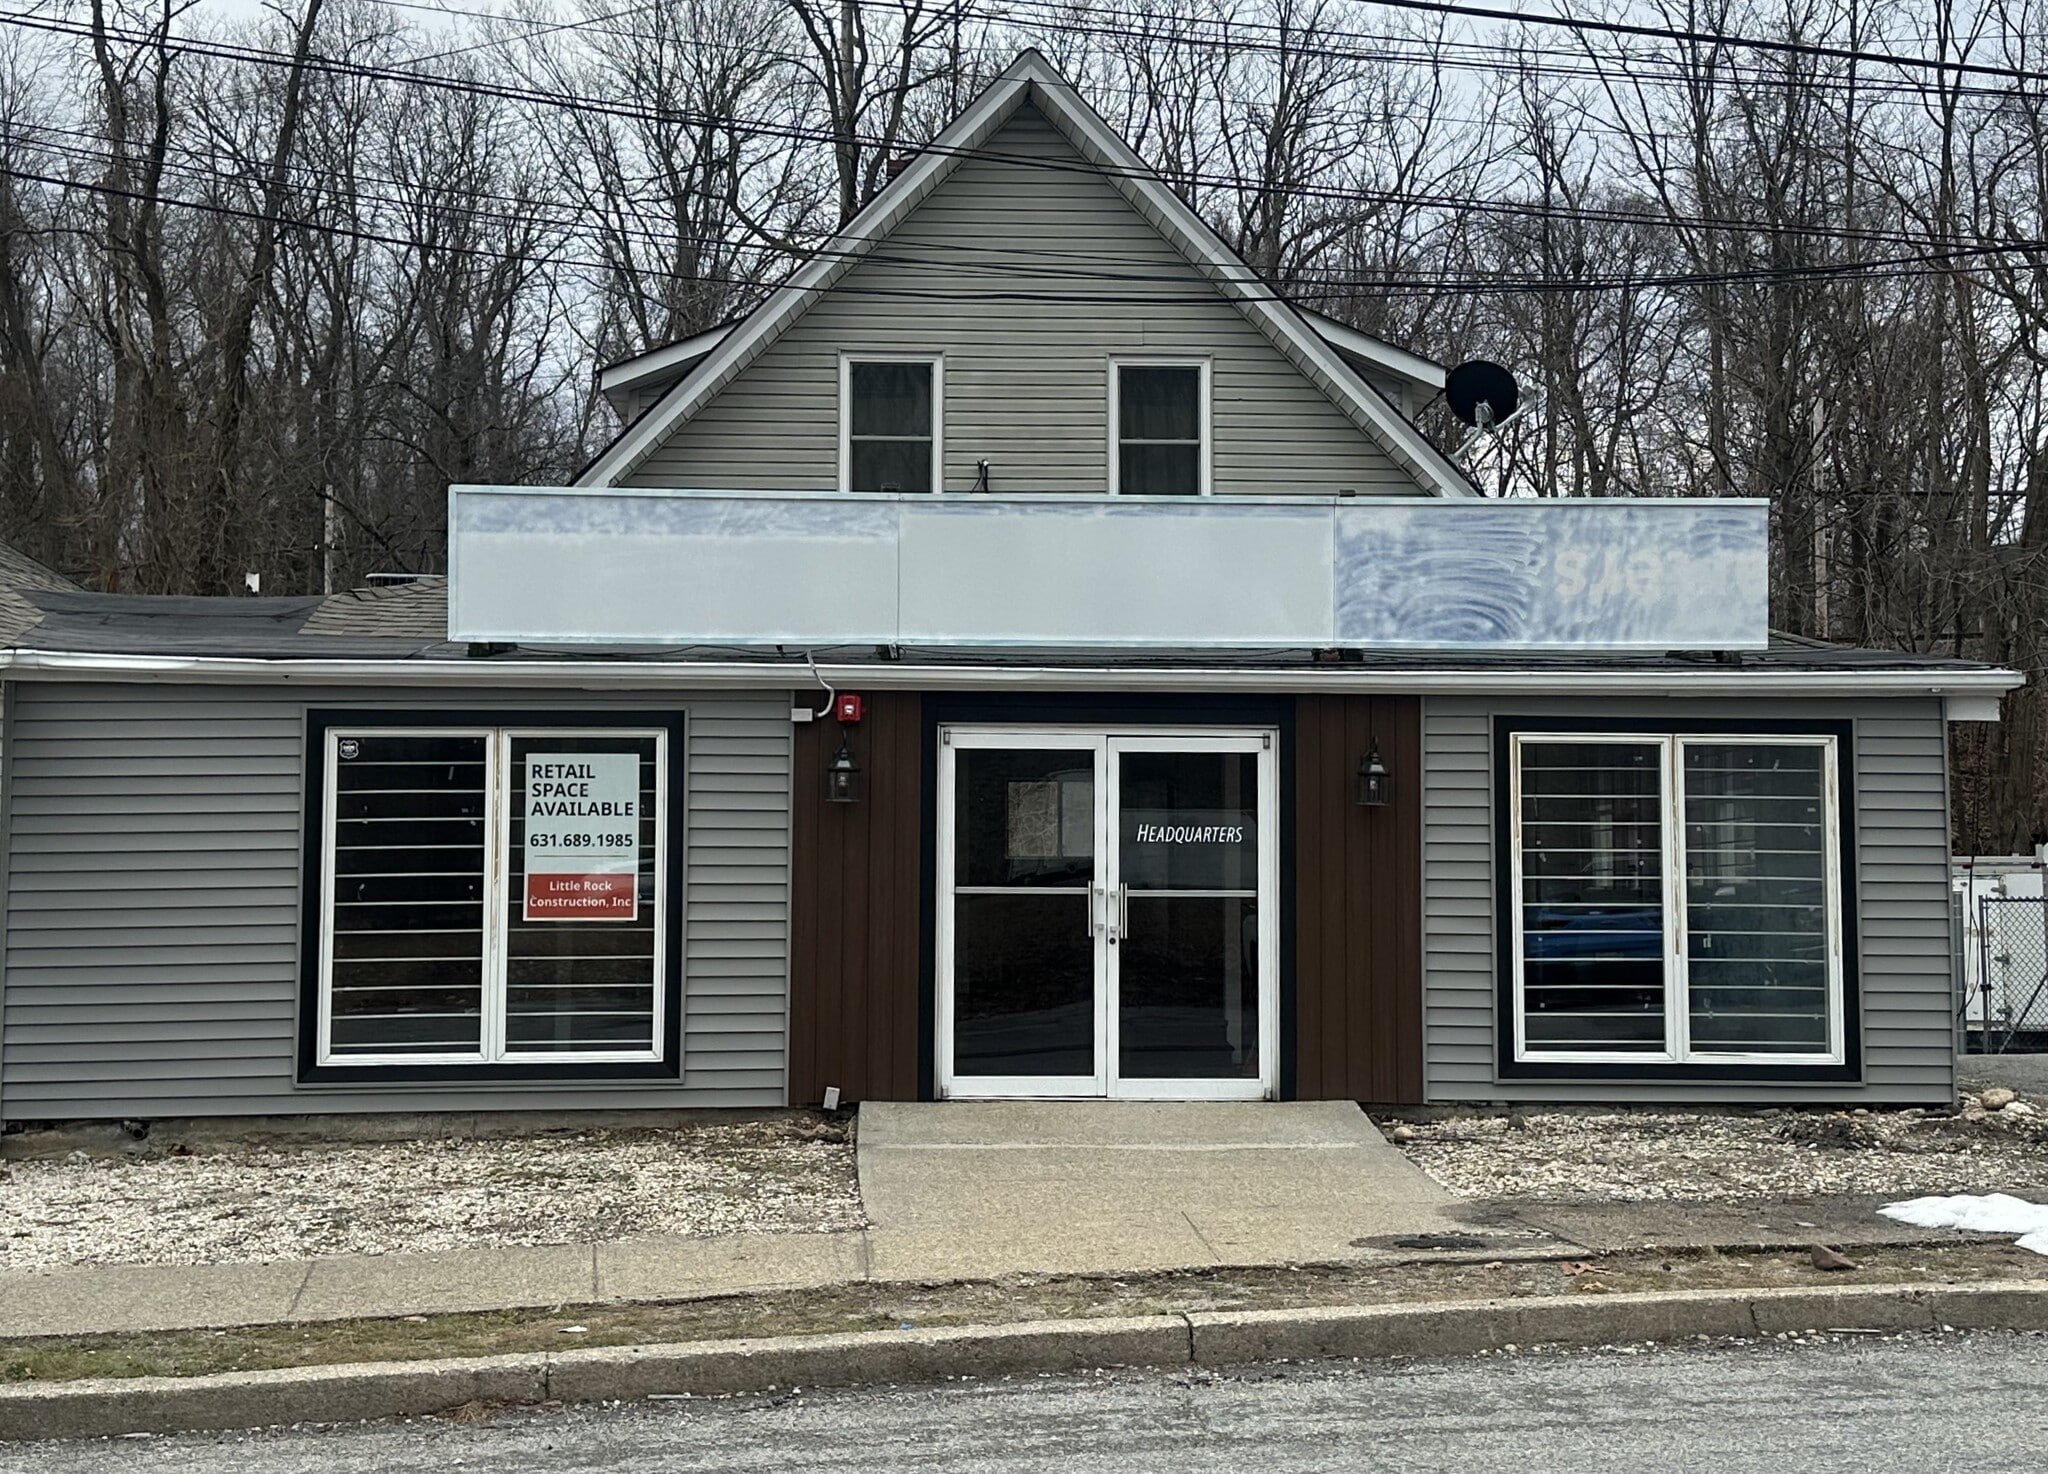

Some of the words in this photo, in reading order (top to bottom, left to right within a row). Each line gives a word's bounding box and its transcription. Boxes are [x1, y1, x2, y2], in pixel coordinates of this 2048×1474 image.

[532, 764, 596, 779] RETAIL
[531, 783, 589, 797] SPACE
[531, 802, 633, 816] AVAILABLE
[530, 833, 633, 847] 631.689.1985
[549, 880, 581, 891] Little
[583, 881, 612, 891] Rock
[529, 896, 610, 908] Construction,
[612, 896, 631, 907] Inc
